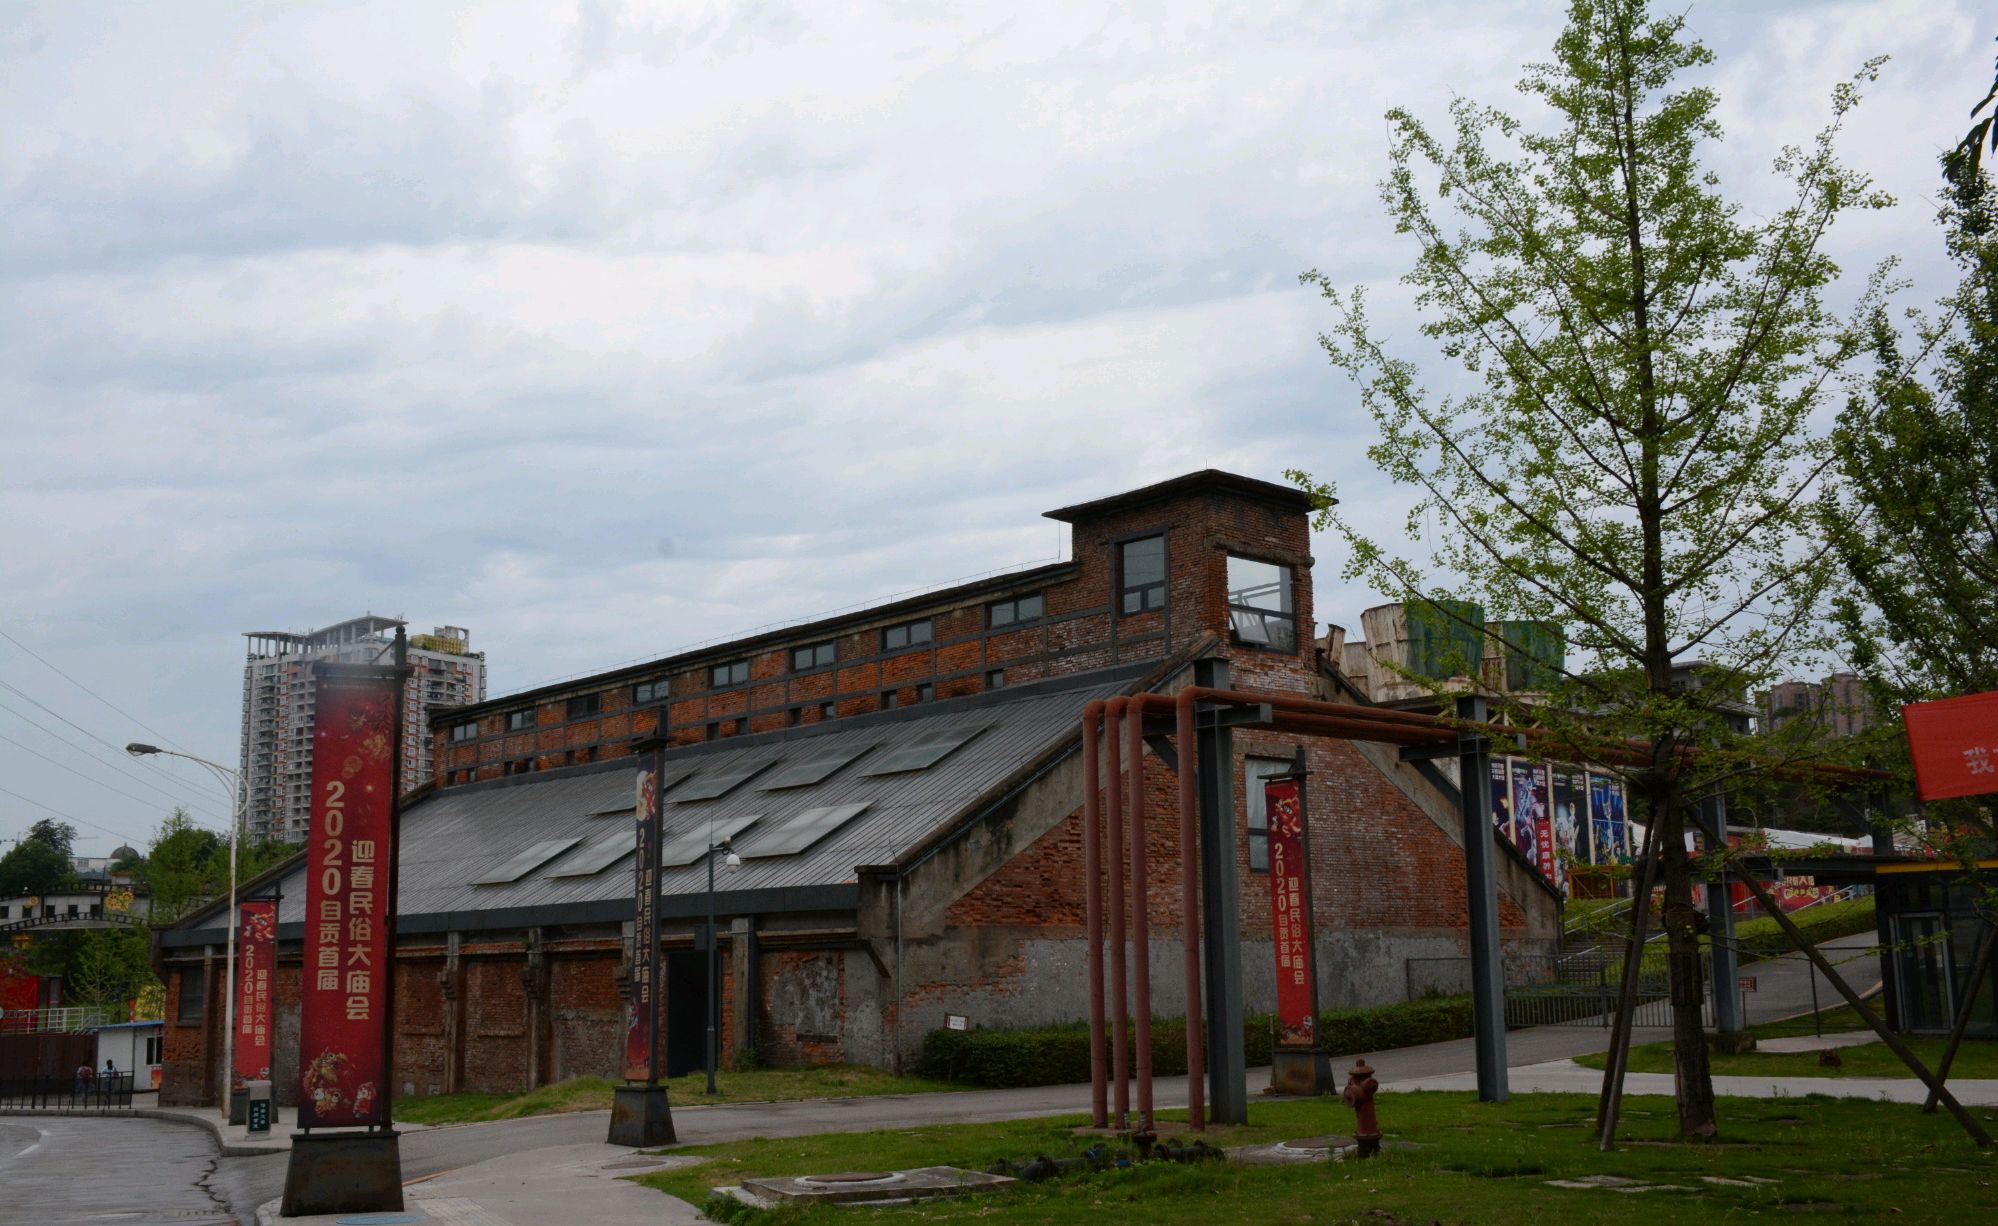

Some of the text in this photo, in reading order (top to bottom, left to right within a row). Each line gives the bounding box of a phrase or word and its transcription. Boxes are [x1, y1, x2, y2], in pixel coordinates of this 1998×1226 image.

[345, 839, 376, 1021] 迎春民俗大庙会
[1288, 877, 1305, 985] 迎春民俗大庙会
